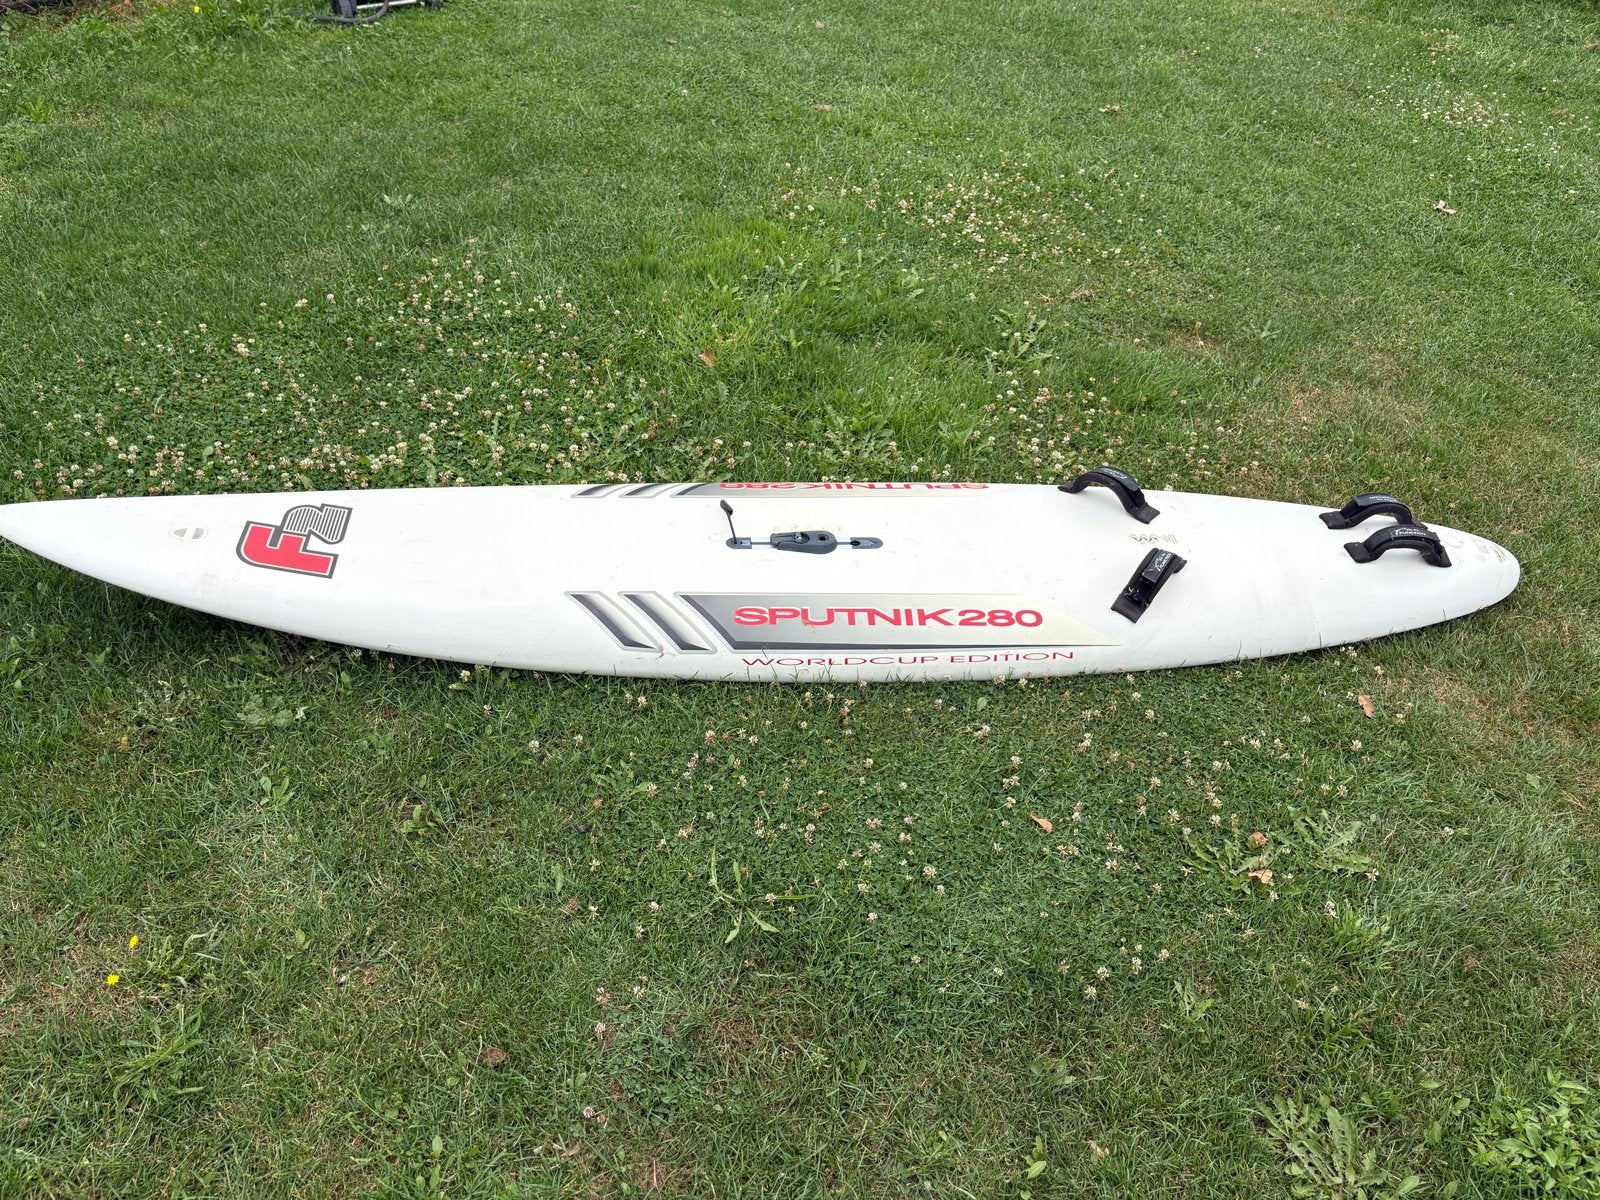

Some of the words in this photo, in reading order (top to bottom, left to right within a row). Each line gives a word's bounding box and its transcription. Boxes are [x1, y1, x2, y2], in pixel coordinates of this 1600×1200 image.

[236, 503, 353, 579] F2
[734, 607, 954, 626] SPUTNIK
[958, 609, 1043, 627] 280
[742, 655, 939, 667] WORLDCUP
[950, 651, 1074, 664] EDITION
